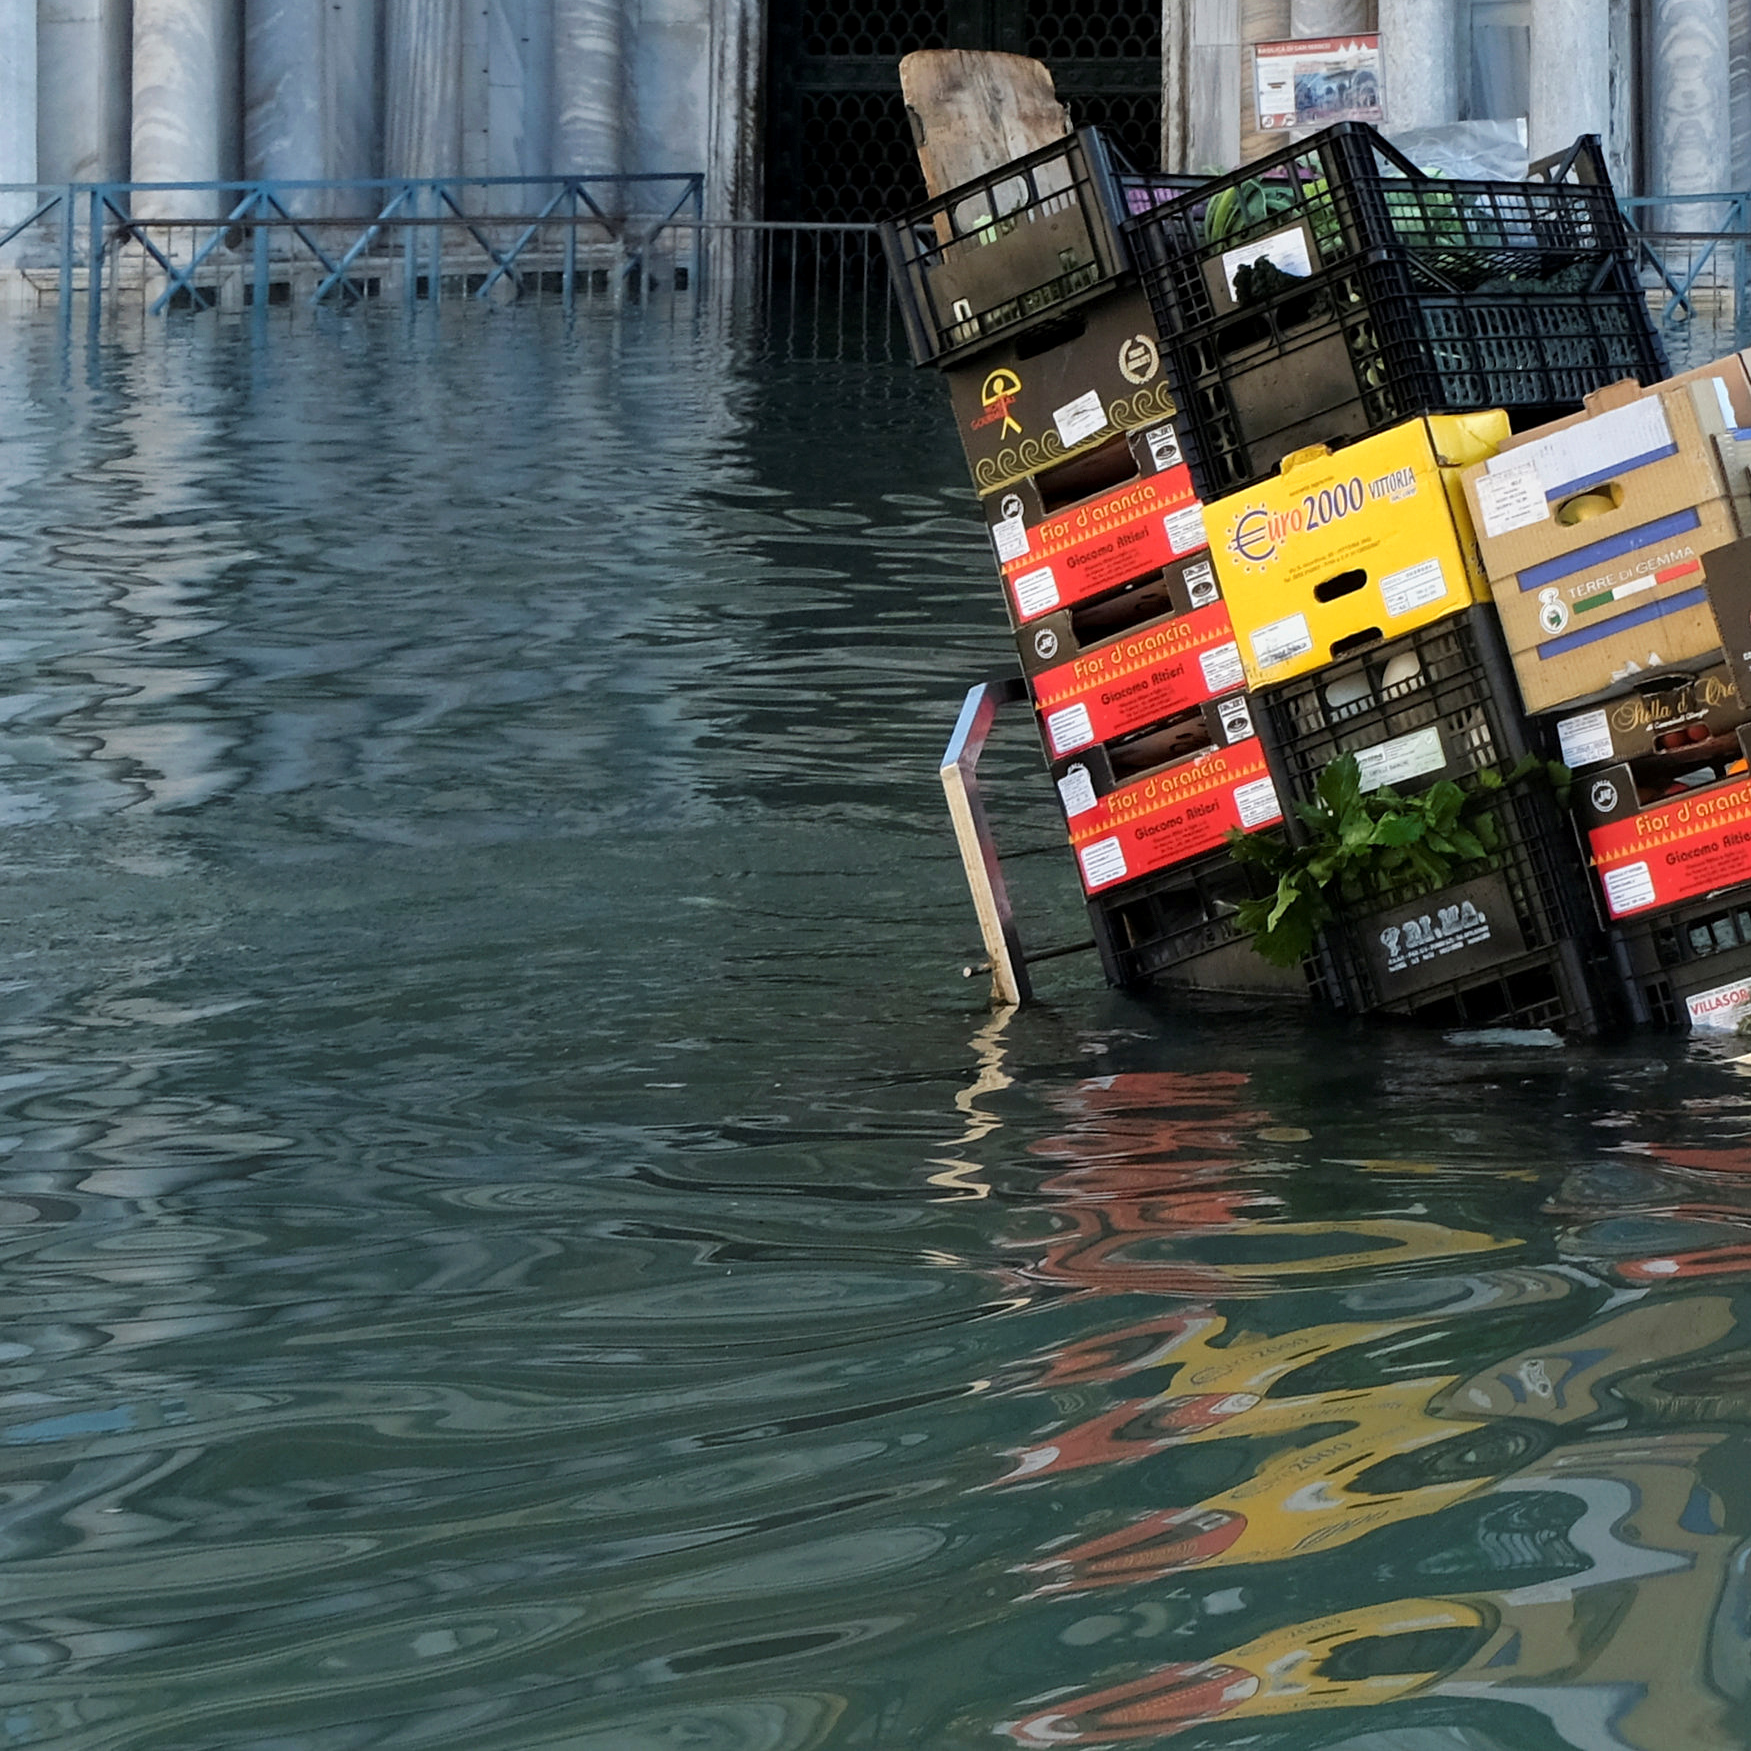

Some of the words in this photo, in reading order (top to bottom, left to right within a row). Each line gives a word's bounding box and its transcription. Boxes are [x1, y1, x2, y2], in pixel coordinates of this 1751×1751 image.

[1368, 466, 1416, 500] VITTORIA
[1039, 522, 1070, 544] Fior
[1076, 483, 1156, 527] d'arancia
[1067, 540, 1114, 569] Giacomo
[1117, 526, 1149, 548] Altieri
[1568, 574, 1617, 599] TERRE
[1618, 567, 1633, 580] DI
[1635, 546, 1696, 574] GEMMA
[1073, 659, 1105, 680] Fior
[1111, 621, 1192, 664] d'arancia
[1101, 678, 1148, 705] Giacomo
[1152, 664, 1184, 686] Altieri
[1612, 697, 1670, 732] Stella
[1107, 793, 1139, 814] Fior
[1144, 757, 1227, 800] d'arancia
[1135, 816, 1184, 840] Giacomo
[1187, 799, 1220, 821] Altieri
[1635, 815, 1670, 837] Fior
[1666, 839, 1719, 866] Giacomo
